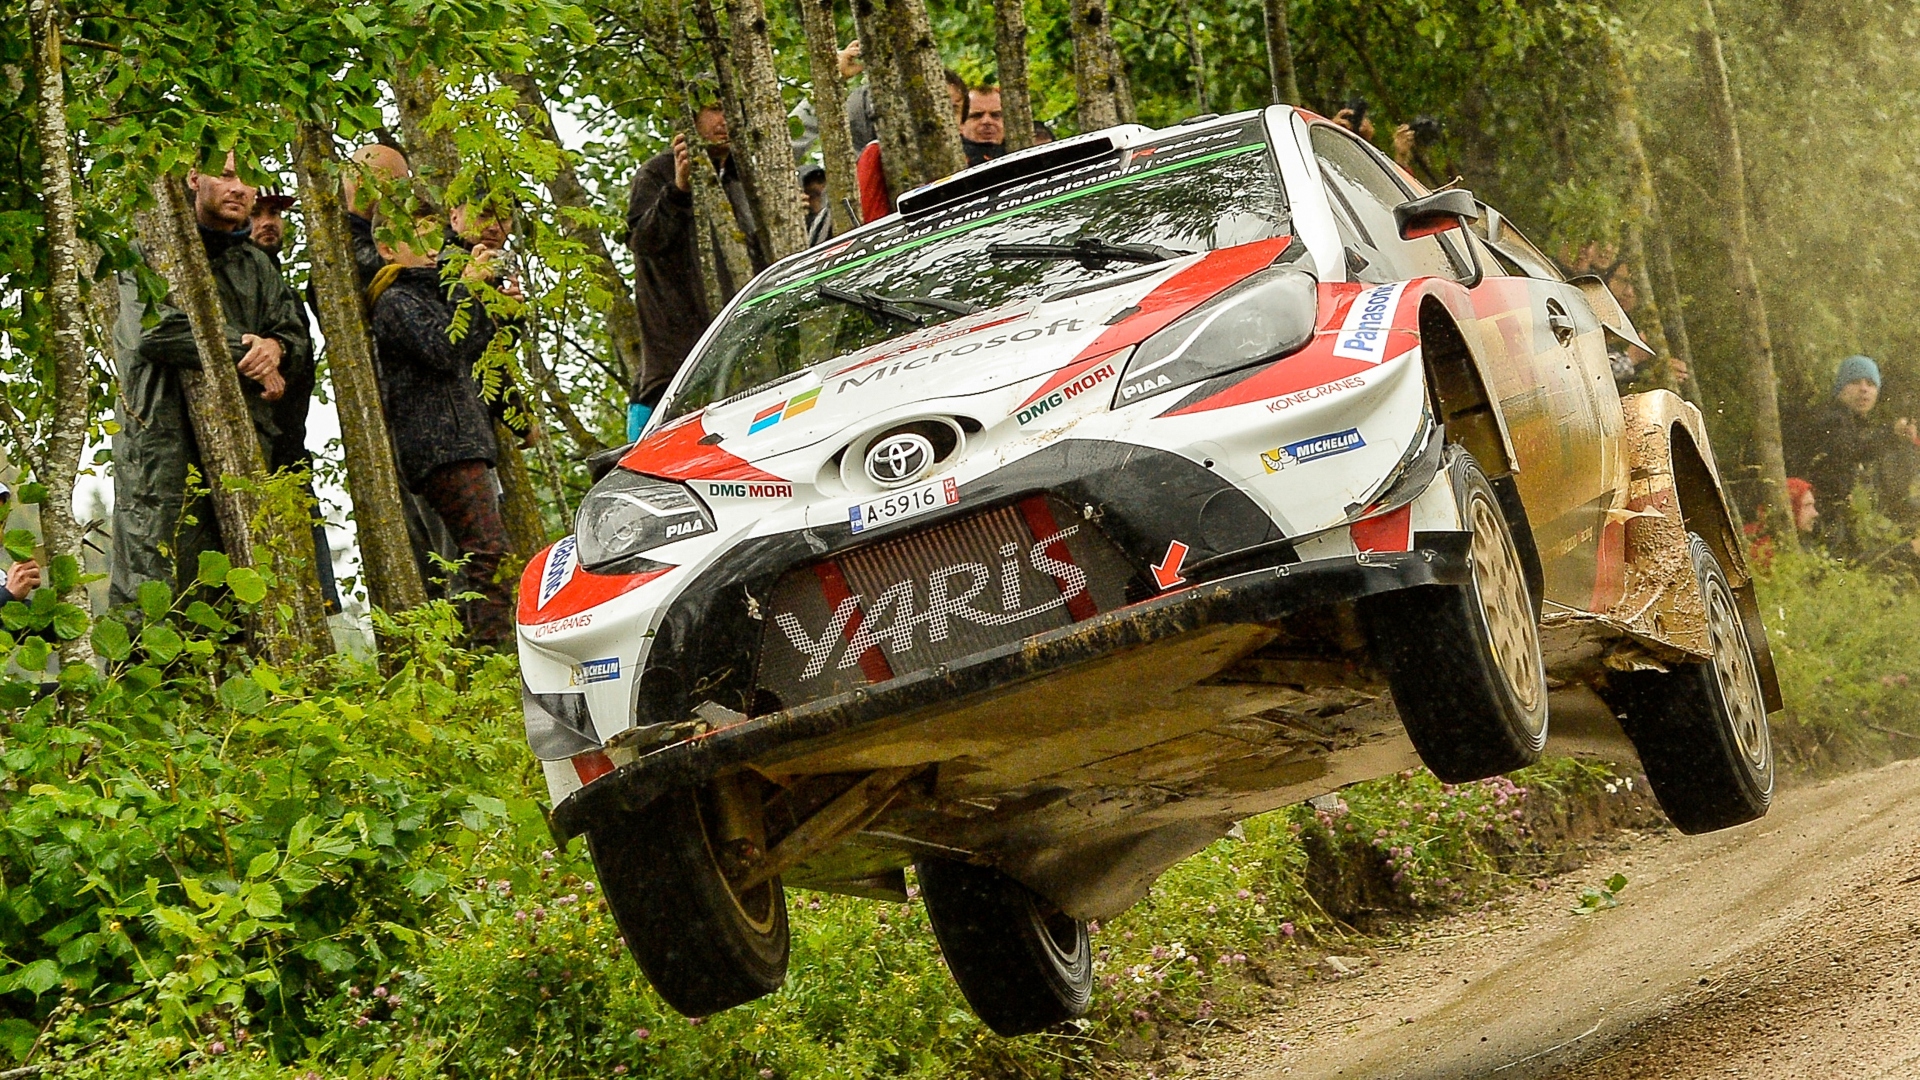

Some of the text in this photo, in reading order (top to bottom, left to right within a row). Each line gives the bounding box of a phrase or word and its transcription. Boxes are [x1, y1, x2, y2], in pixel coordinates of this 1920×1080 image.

[834, 165, 1142, 266] FIA World Rally Championship
[861, 194, 990, 244] TOYOTA
[998, 158, 1120, 198] GAZOO
[837, 317, 1083, 395] Microsoft
[1016, 364, 1116, 426] DMG MORI
[1121, 374, 1172, 400] PIAA
[1266, 376, 1366, 414] KONECRANES
[1296, 432, 1360, 458] MICHELIN
[709, 483, 793, 498] DMG MORI
[944, 479, 955, 490] 12
[946, 490, 956, 501] 17
[665, 519, 704, 539] PIAA
[544, 536, 576, 600] nasonic
